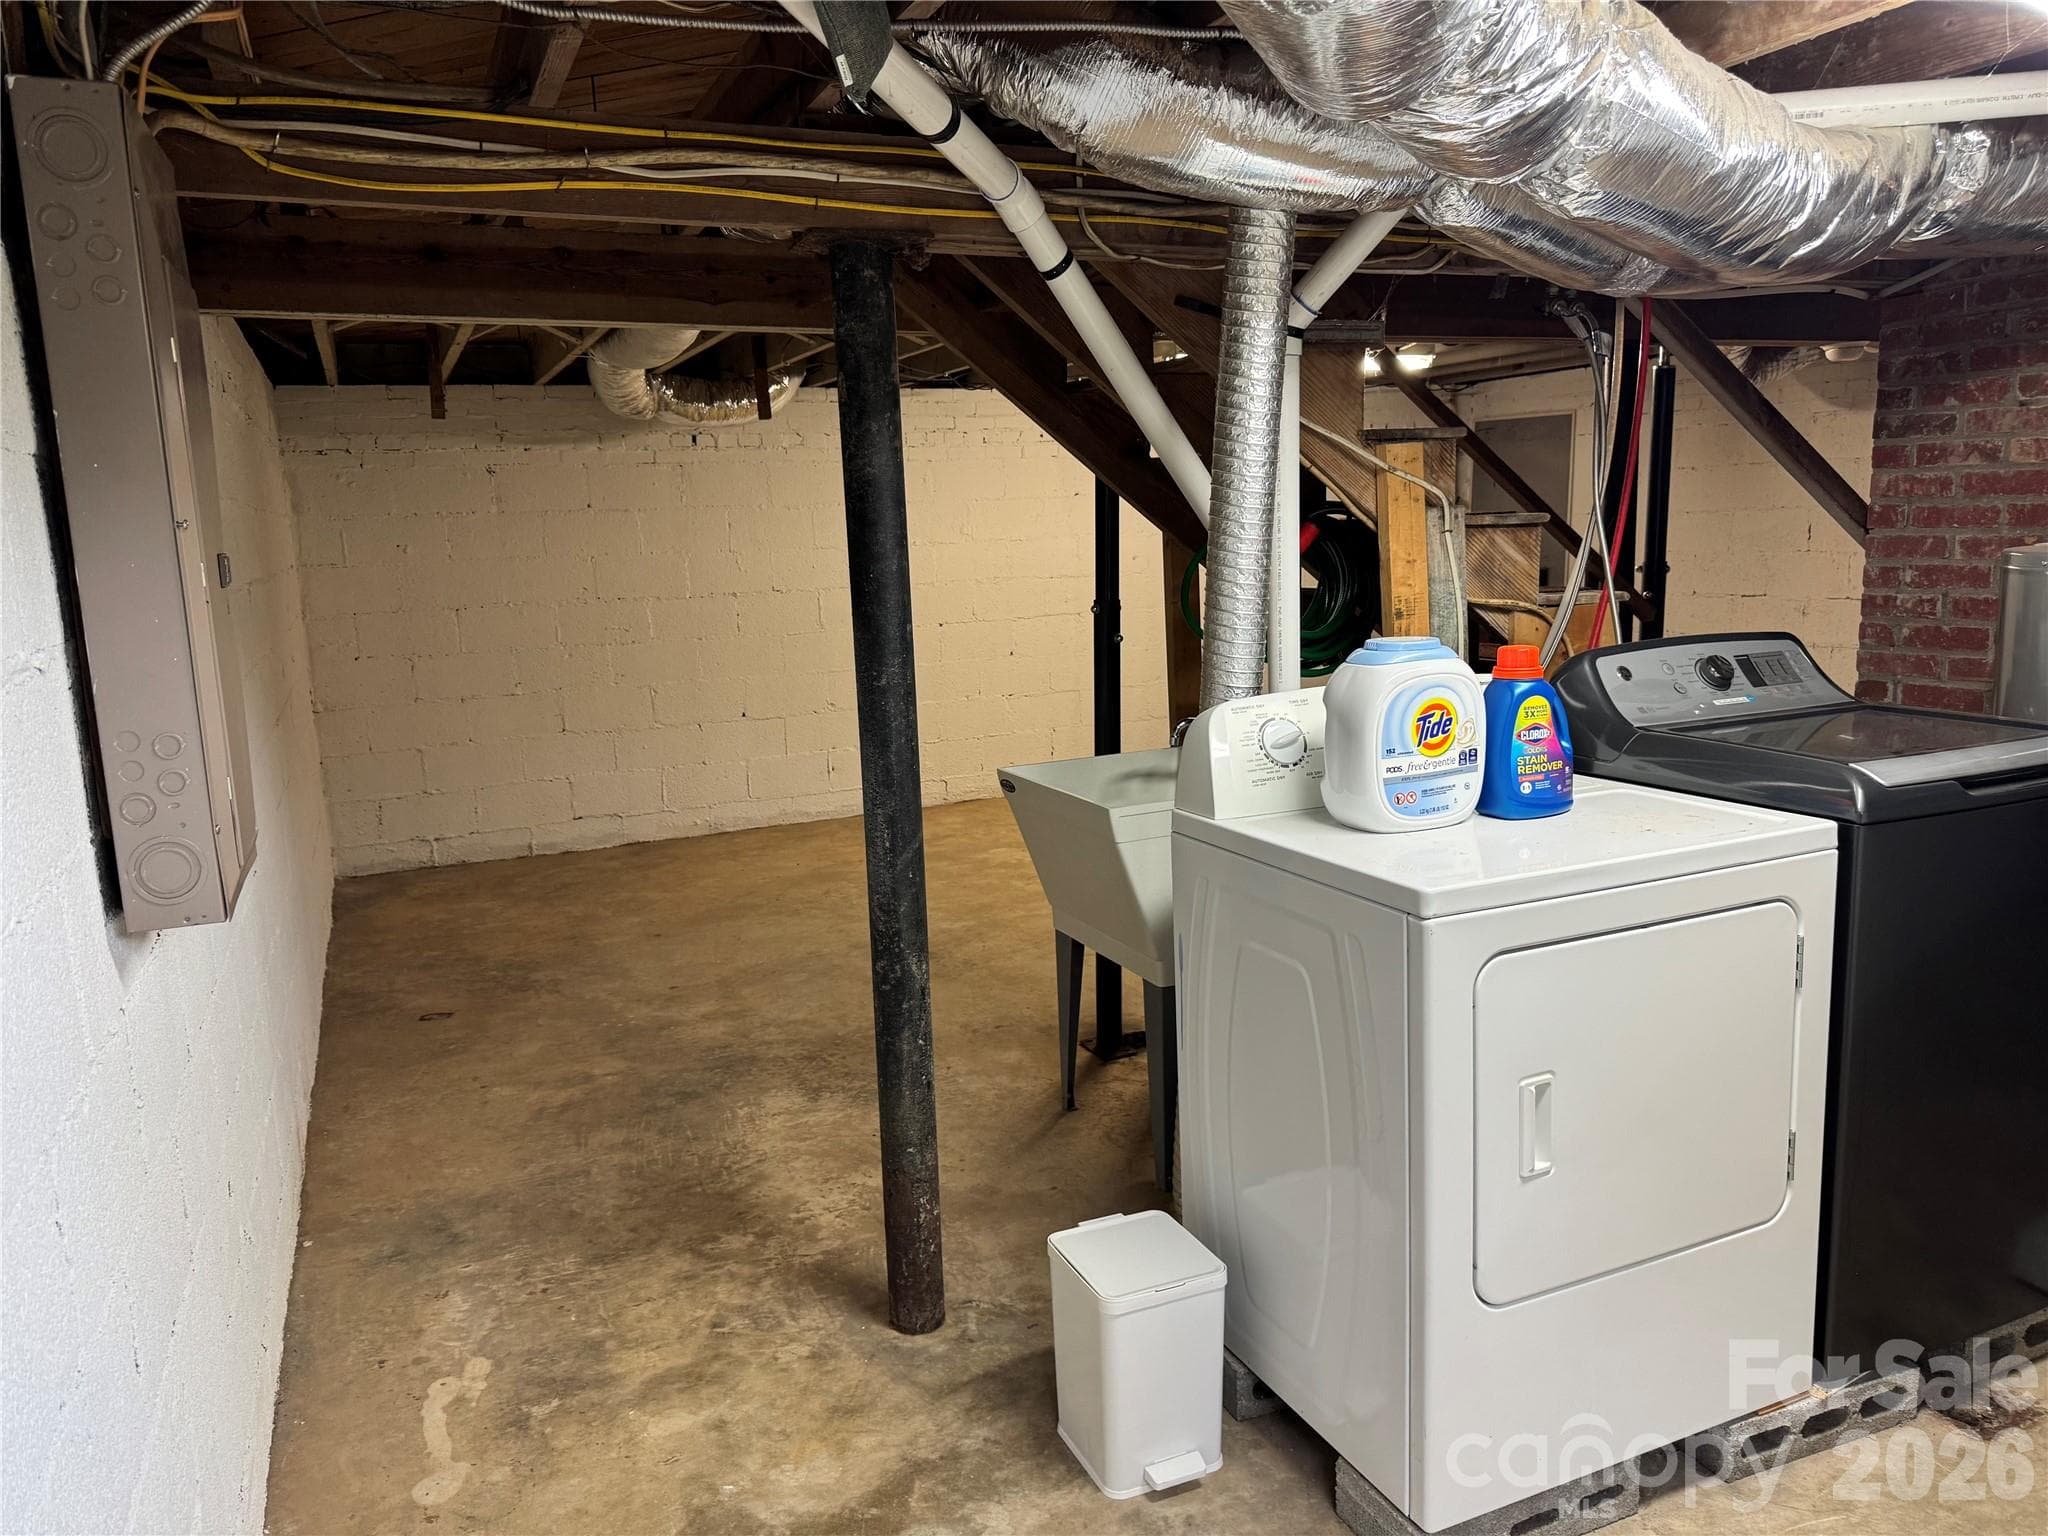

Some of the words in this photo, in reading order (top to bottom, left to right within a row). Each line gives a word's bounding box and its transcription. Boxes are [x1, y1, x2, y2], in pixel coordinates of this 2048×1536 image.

[1523, 710, 1536, 719] 3X
[1416, 710, 1453, 748] Tide
[1520, 728, 1550, 741] CLOROX
[1517, 754, 1547, 766] STAIN
[1386, 765, 1403, 774] PODS
[1517, 760, 1563, 775] REMOVER
